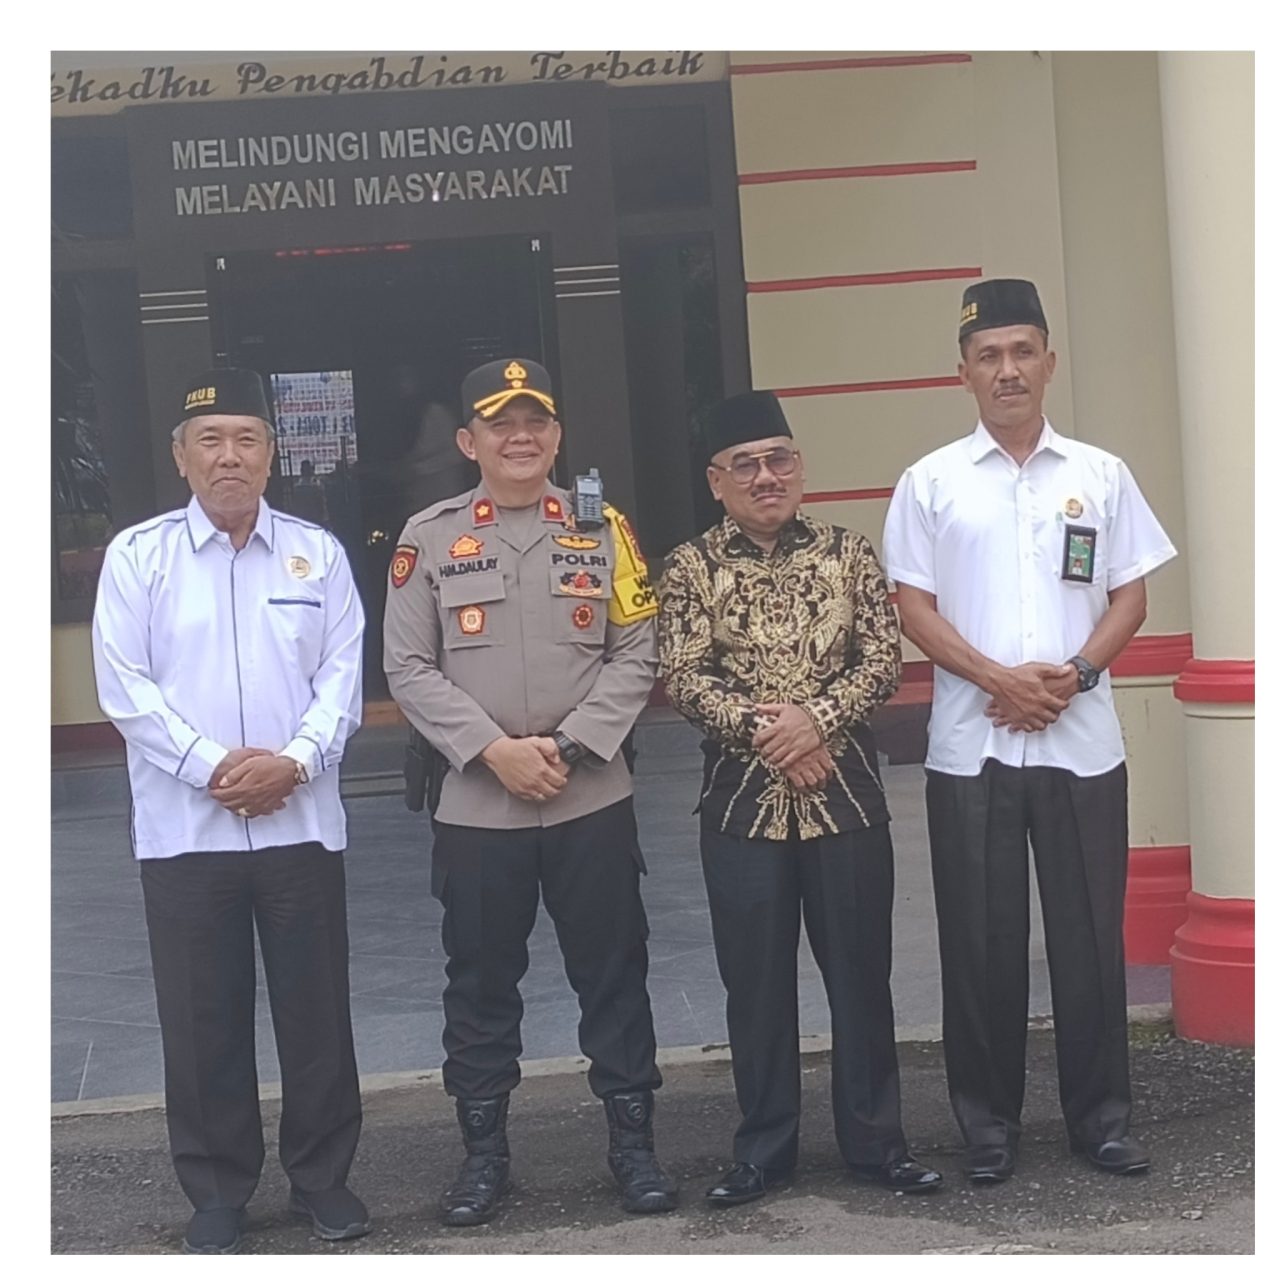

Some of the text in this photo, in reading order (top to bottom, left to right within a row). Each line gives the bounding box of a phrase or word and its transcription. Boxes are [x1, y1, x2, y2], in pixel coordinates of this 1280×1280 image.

[51, 51, 705, 104] ekadku Pengabdian Terbaik
[172, 119, 574, 171] MELINDUNGI MENGAYOMI
[174, 165, 573, 216] MELAYANI MASYARAKAT
[552, 554, 607, 567] POLRI
